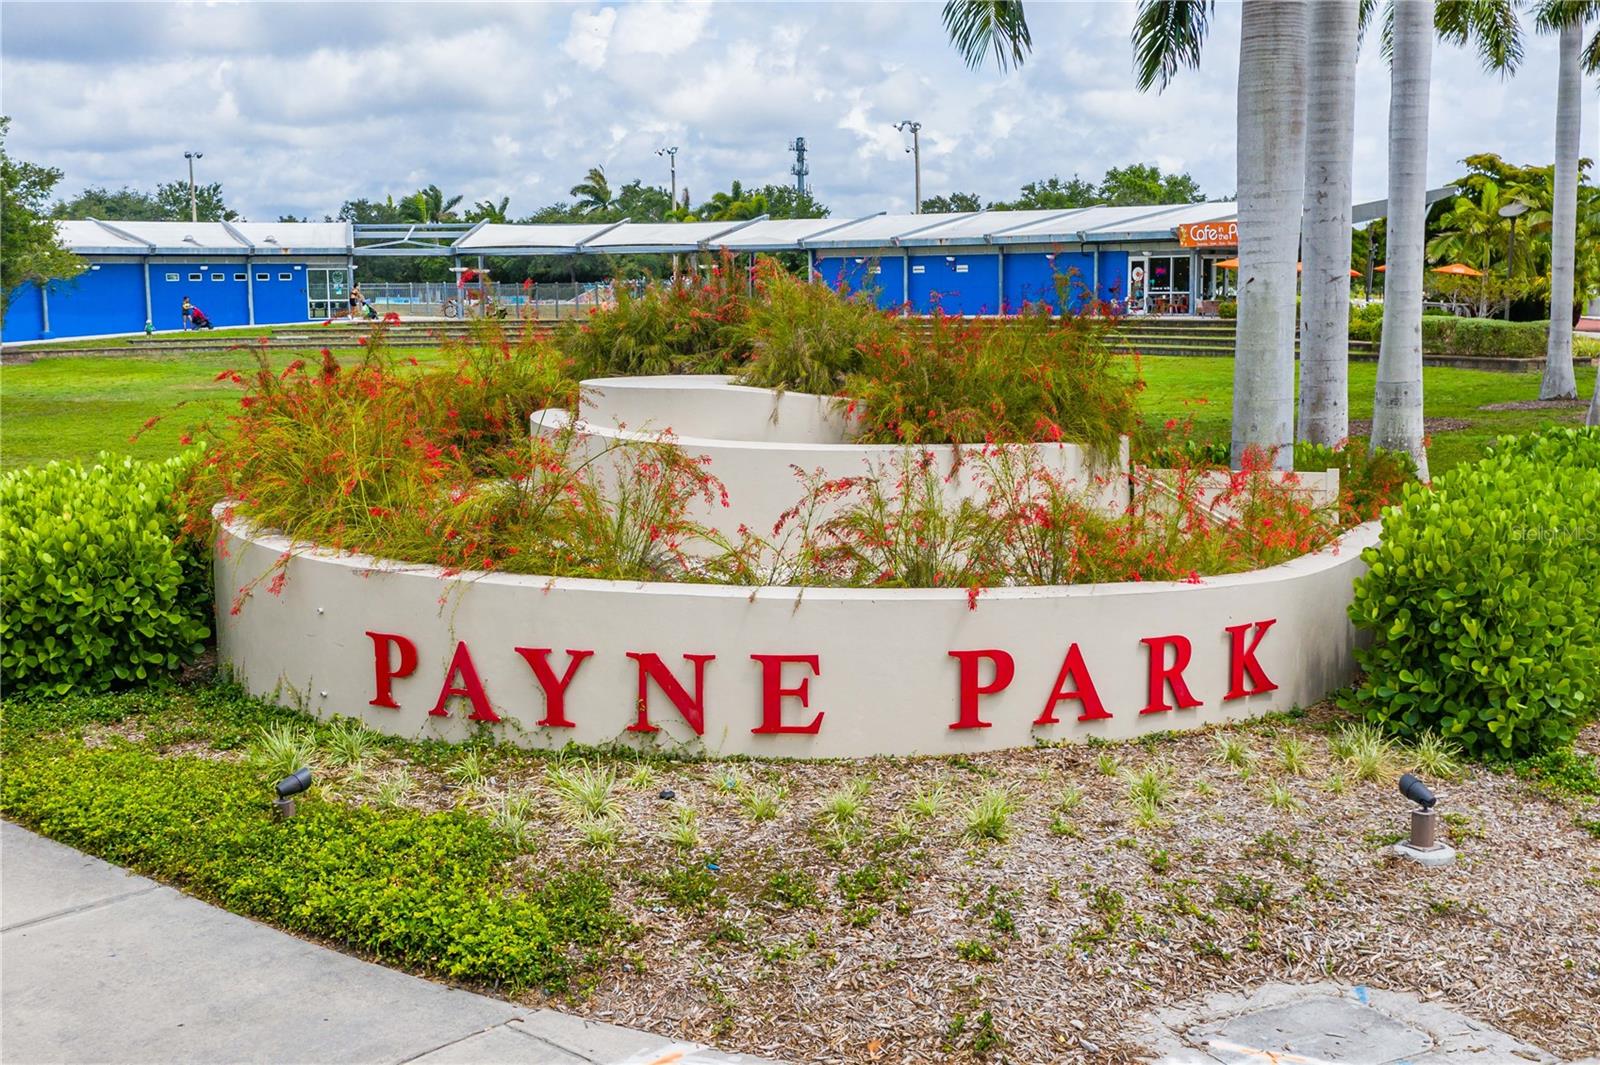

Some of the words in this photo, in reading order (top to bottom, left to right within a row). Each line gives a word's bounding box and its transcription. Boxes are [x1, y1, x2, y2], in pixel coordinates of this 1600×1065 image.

[1190, 224, 1218, 241] Cafe
[366, 631, 825, 736] PAYNE
[948, 619, 1279, 731] PARK
